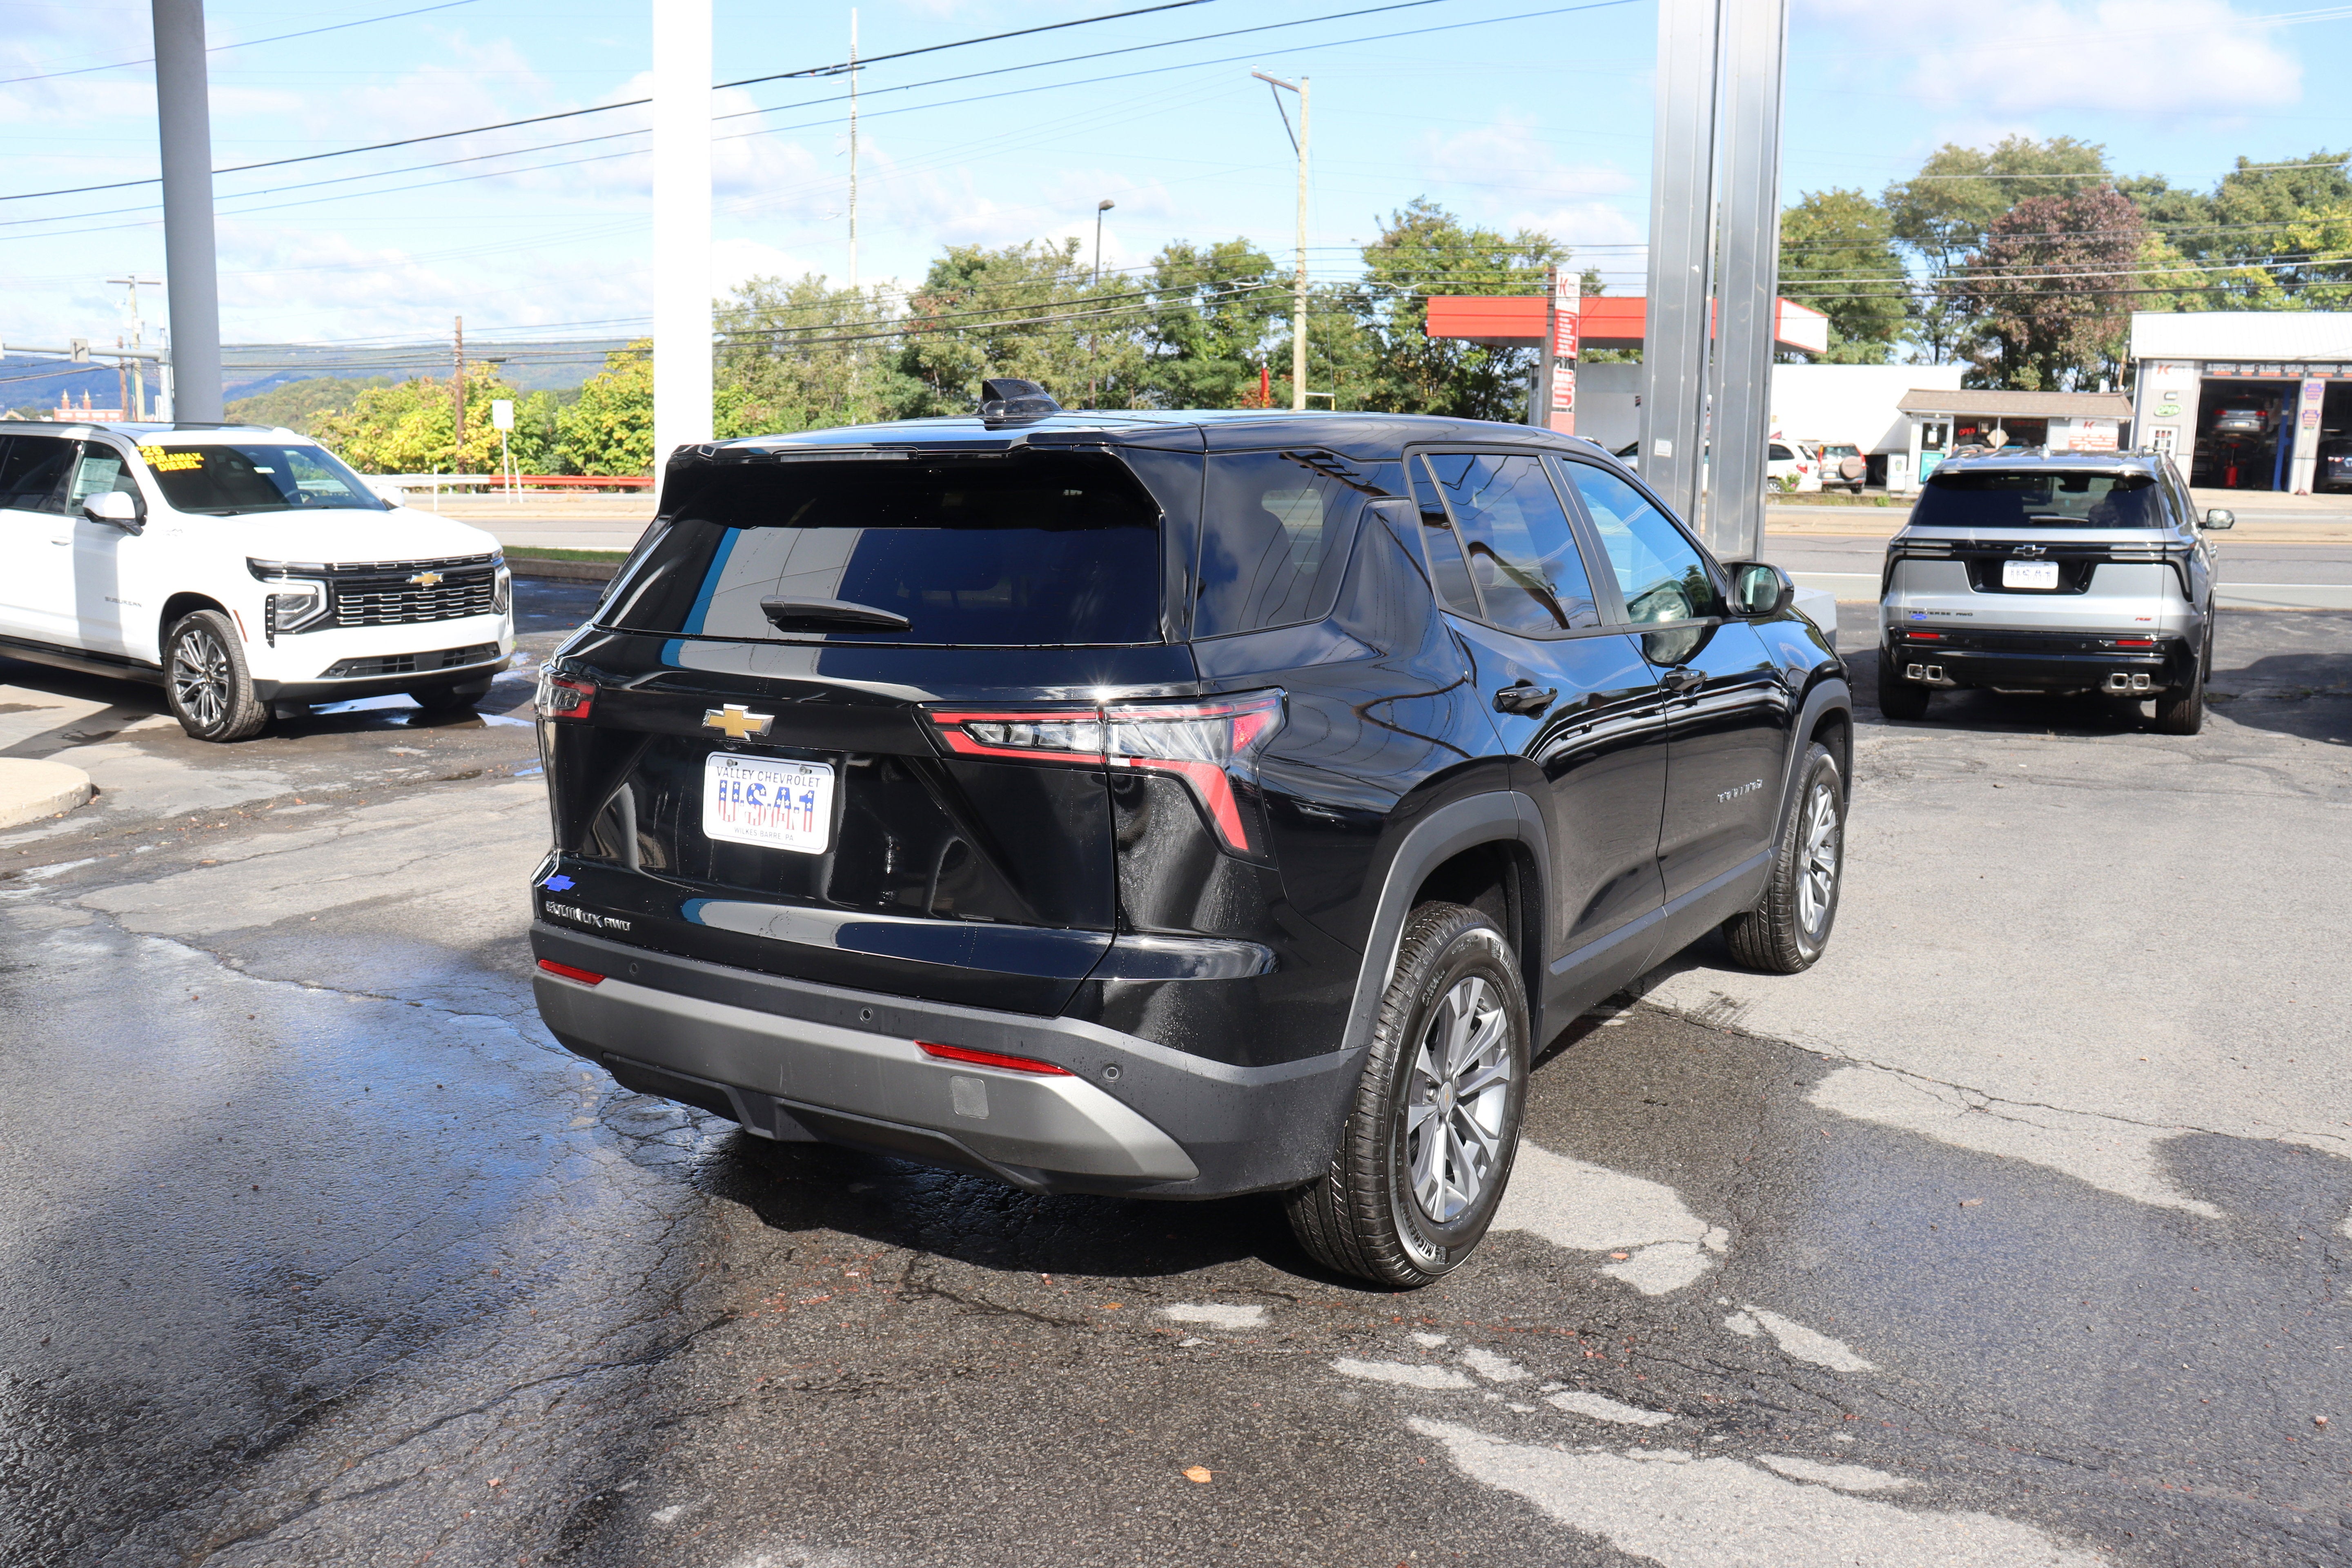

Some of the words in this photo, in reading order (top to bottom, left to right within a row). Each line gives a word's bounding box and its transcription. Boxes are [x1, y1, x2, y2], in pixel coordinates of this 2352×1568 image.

[2157, 405, 2180, 414] OPEN
[1958, 427, 1976, 436] OPEN
[143, 452, 205, 465] DURAMAX
[156, 460, 203, 472] DIESEL
[717, 766, 754, 780] VALLEY
[757, 771, 821, 788] CHEVROLET
[734, 826, 757, 836] WILKES
[545, 900, 604, 928] EQUINOX
[604, 917, 632, 931] AWD
[1402, 1203, 1434, 1257] MICHELIN
